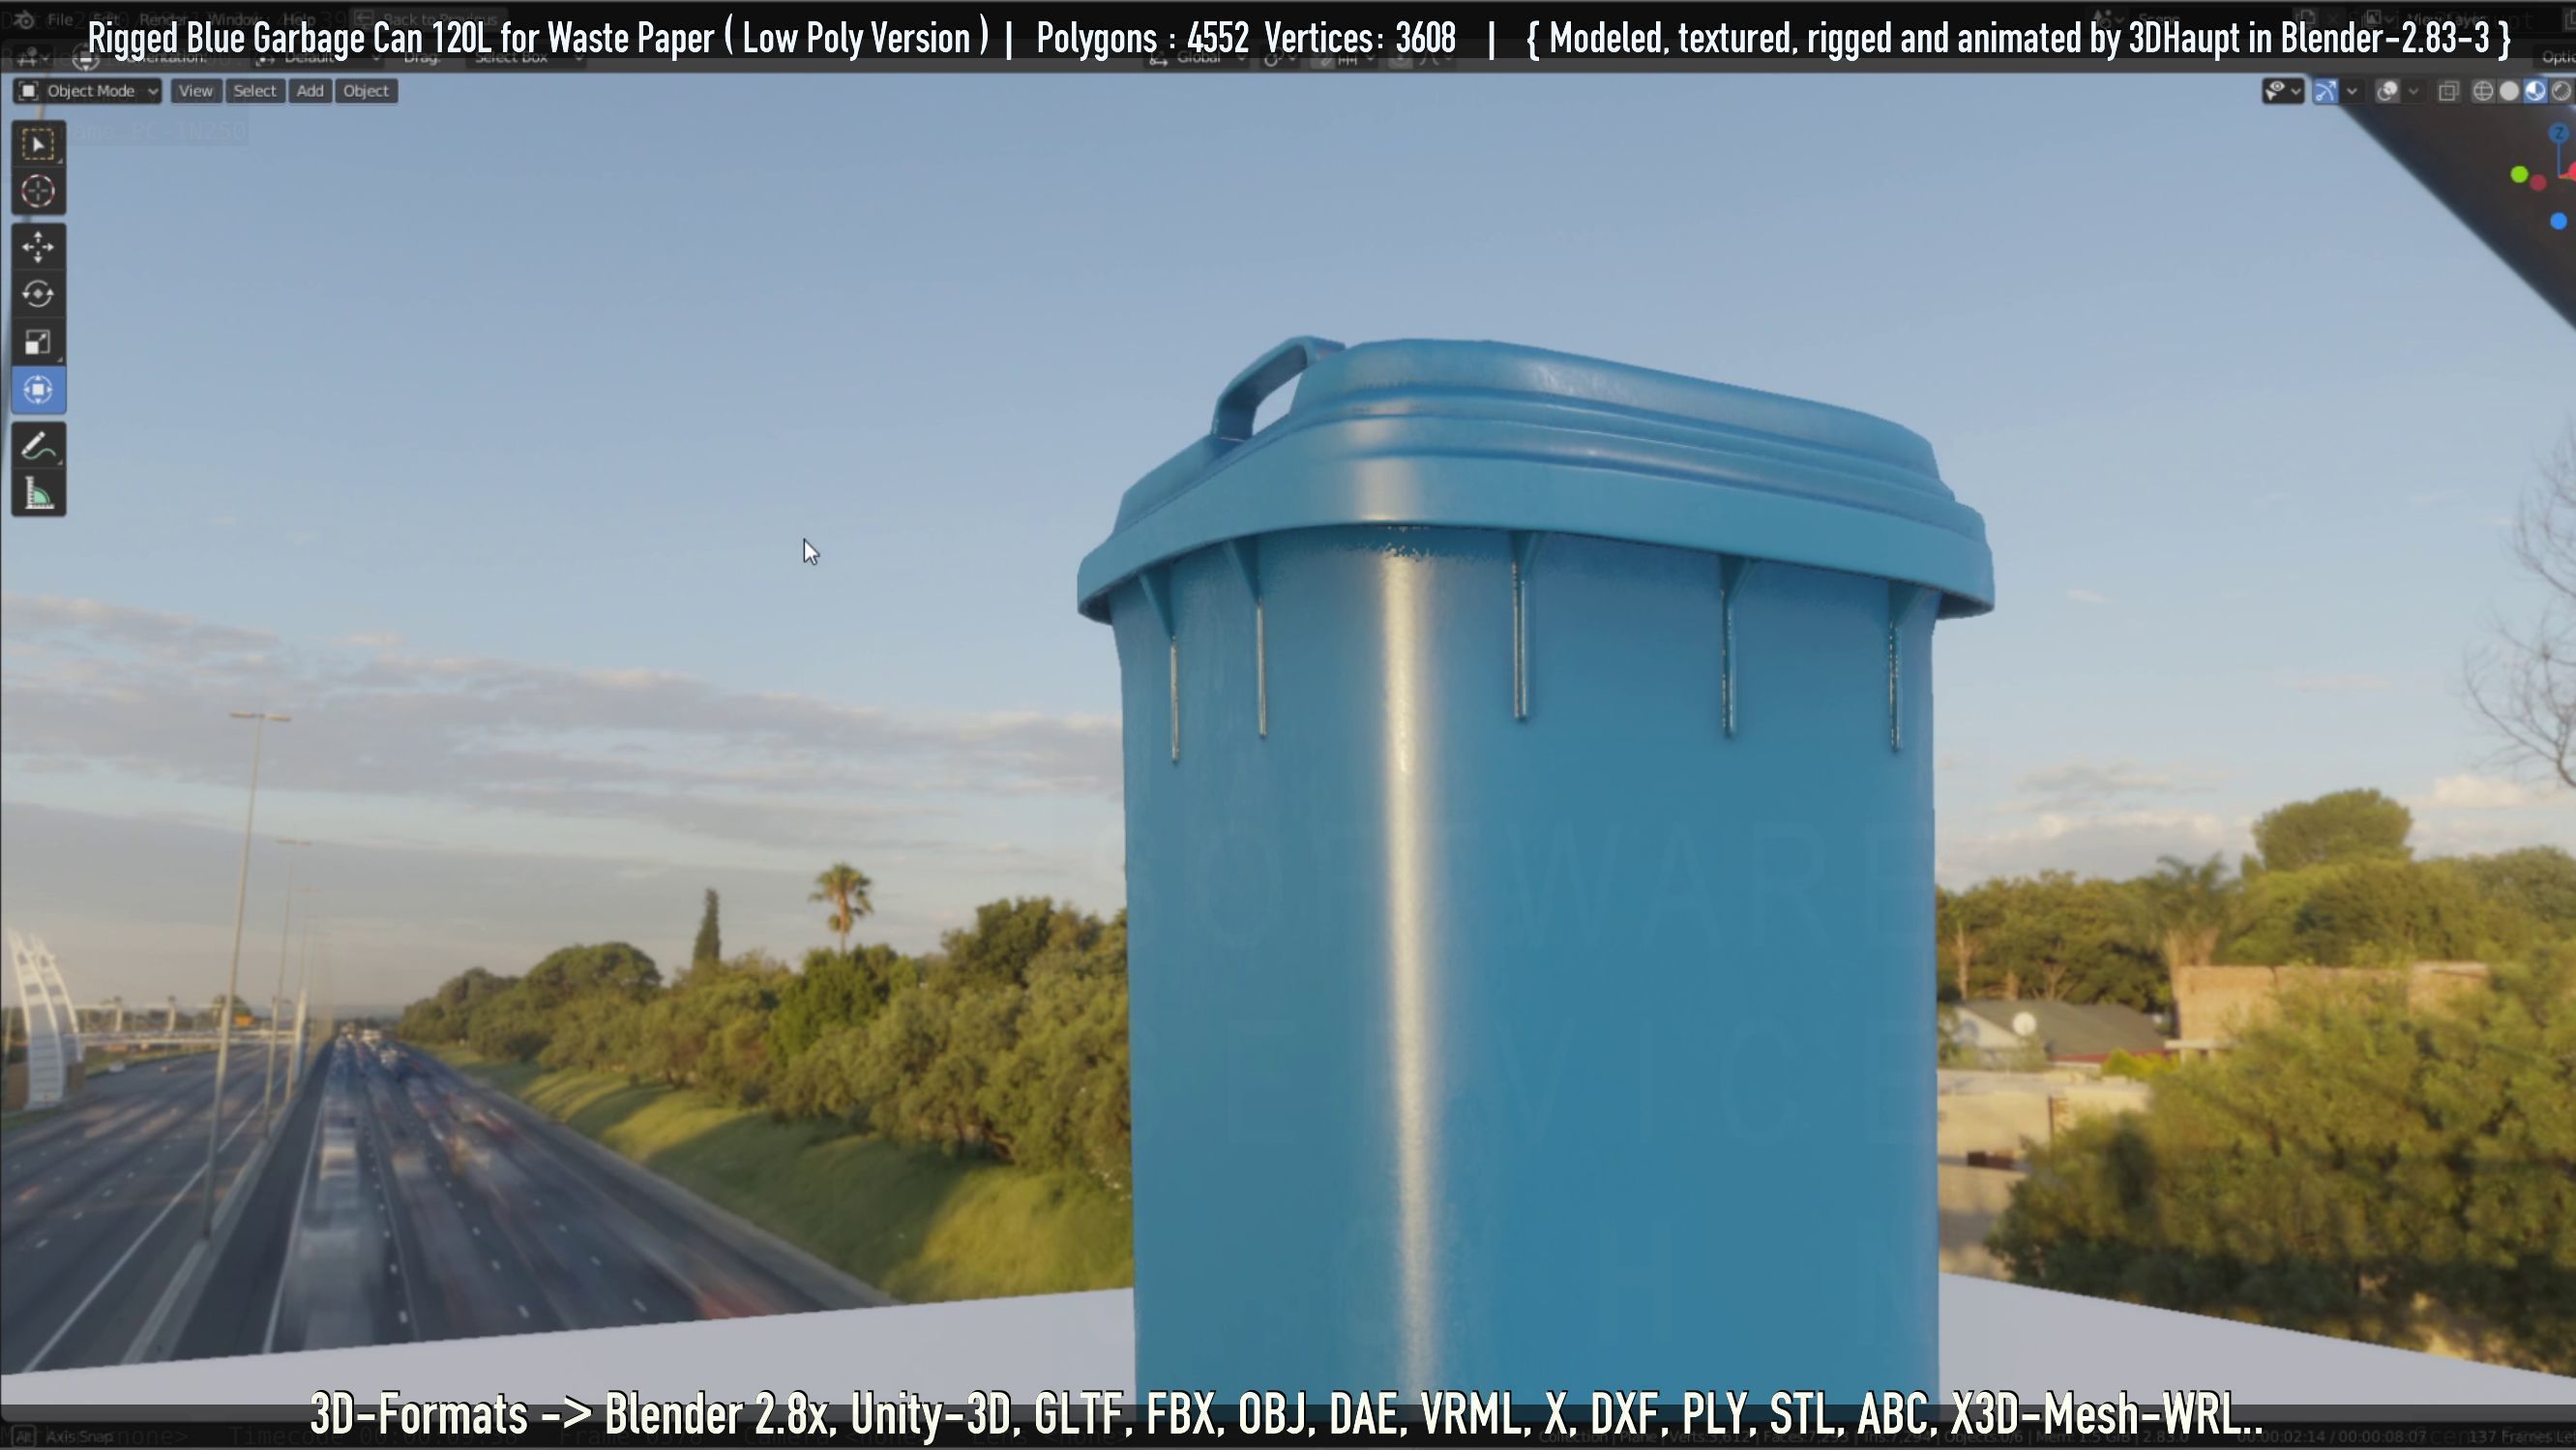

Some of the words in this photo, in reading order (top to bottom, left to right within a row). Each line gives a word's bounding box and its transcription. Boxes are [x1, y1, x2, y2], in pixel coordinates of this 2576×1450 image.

[48, 85, 93, 101] Object
[98, 84, 135, 98] Mode
[178, 84, 213, 98] View
[233, 84, 277, 98] Select
[296, 84, 325, 98] Add
[343, 84, 391, 101] Object
[2555, 127, 2564, 139] Z
